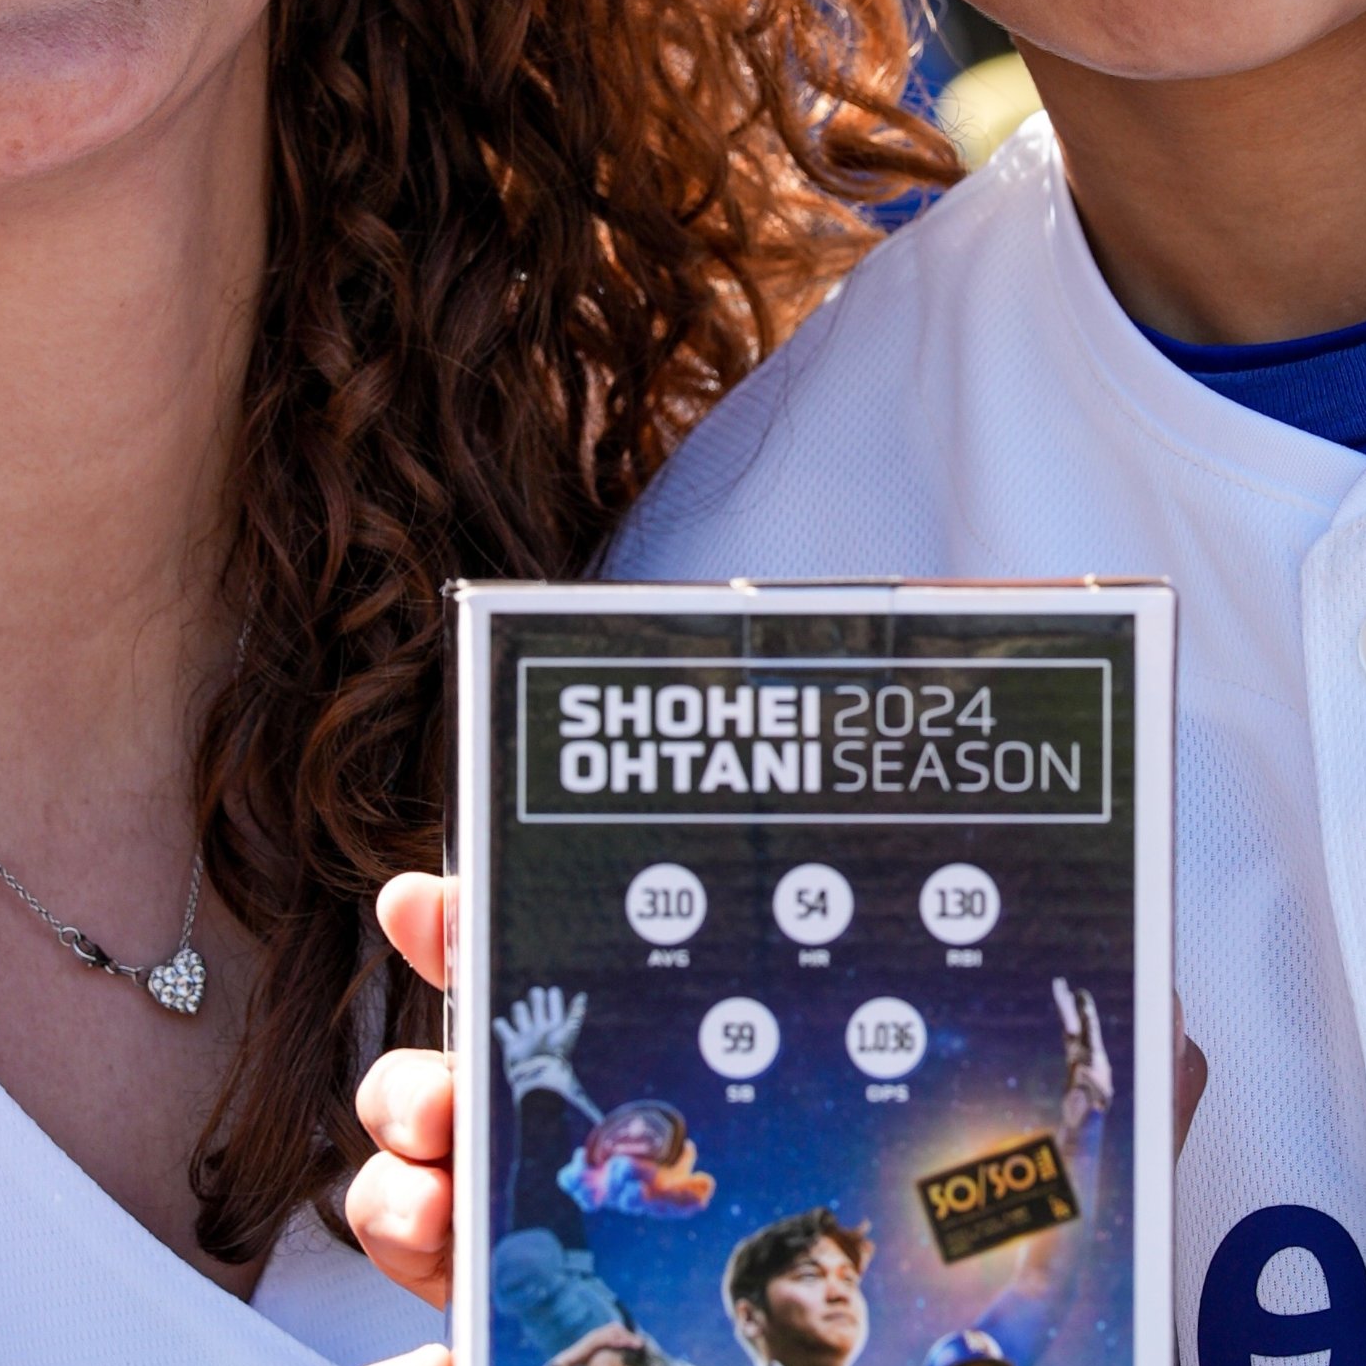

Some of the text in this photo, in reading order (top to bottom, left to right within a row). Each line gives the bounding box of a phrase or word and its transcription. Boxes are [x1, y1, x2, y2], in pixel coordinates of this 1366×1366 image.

[559, 685, 996, 738] SHOHEI 2024
[559, 741, 1080, 794] OHTANI SEASON
[636, 887, 695, 920] .310
[796, 887, 829, 919] 54
[935, 887, 987, 919] 130
[647, 949, 690, 968] AVG
[798, 949, 830, 967] HR
[945, 949, 983, 967] RBI
[722, 1021, 756, 1054] 59
